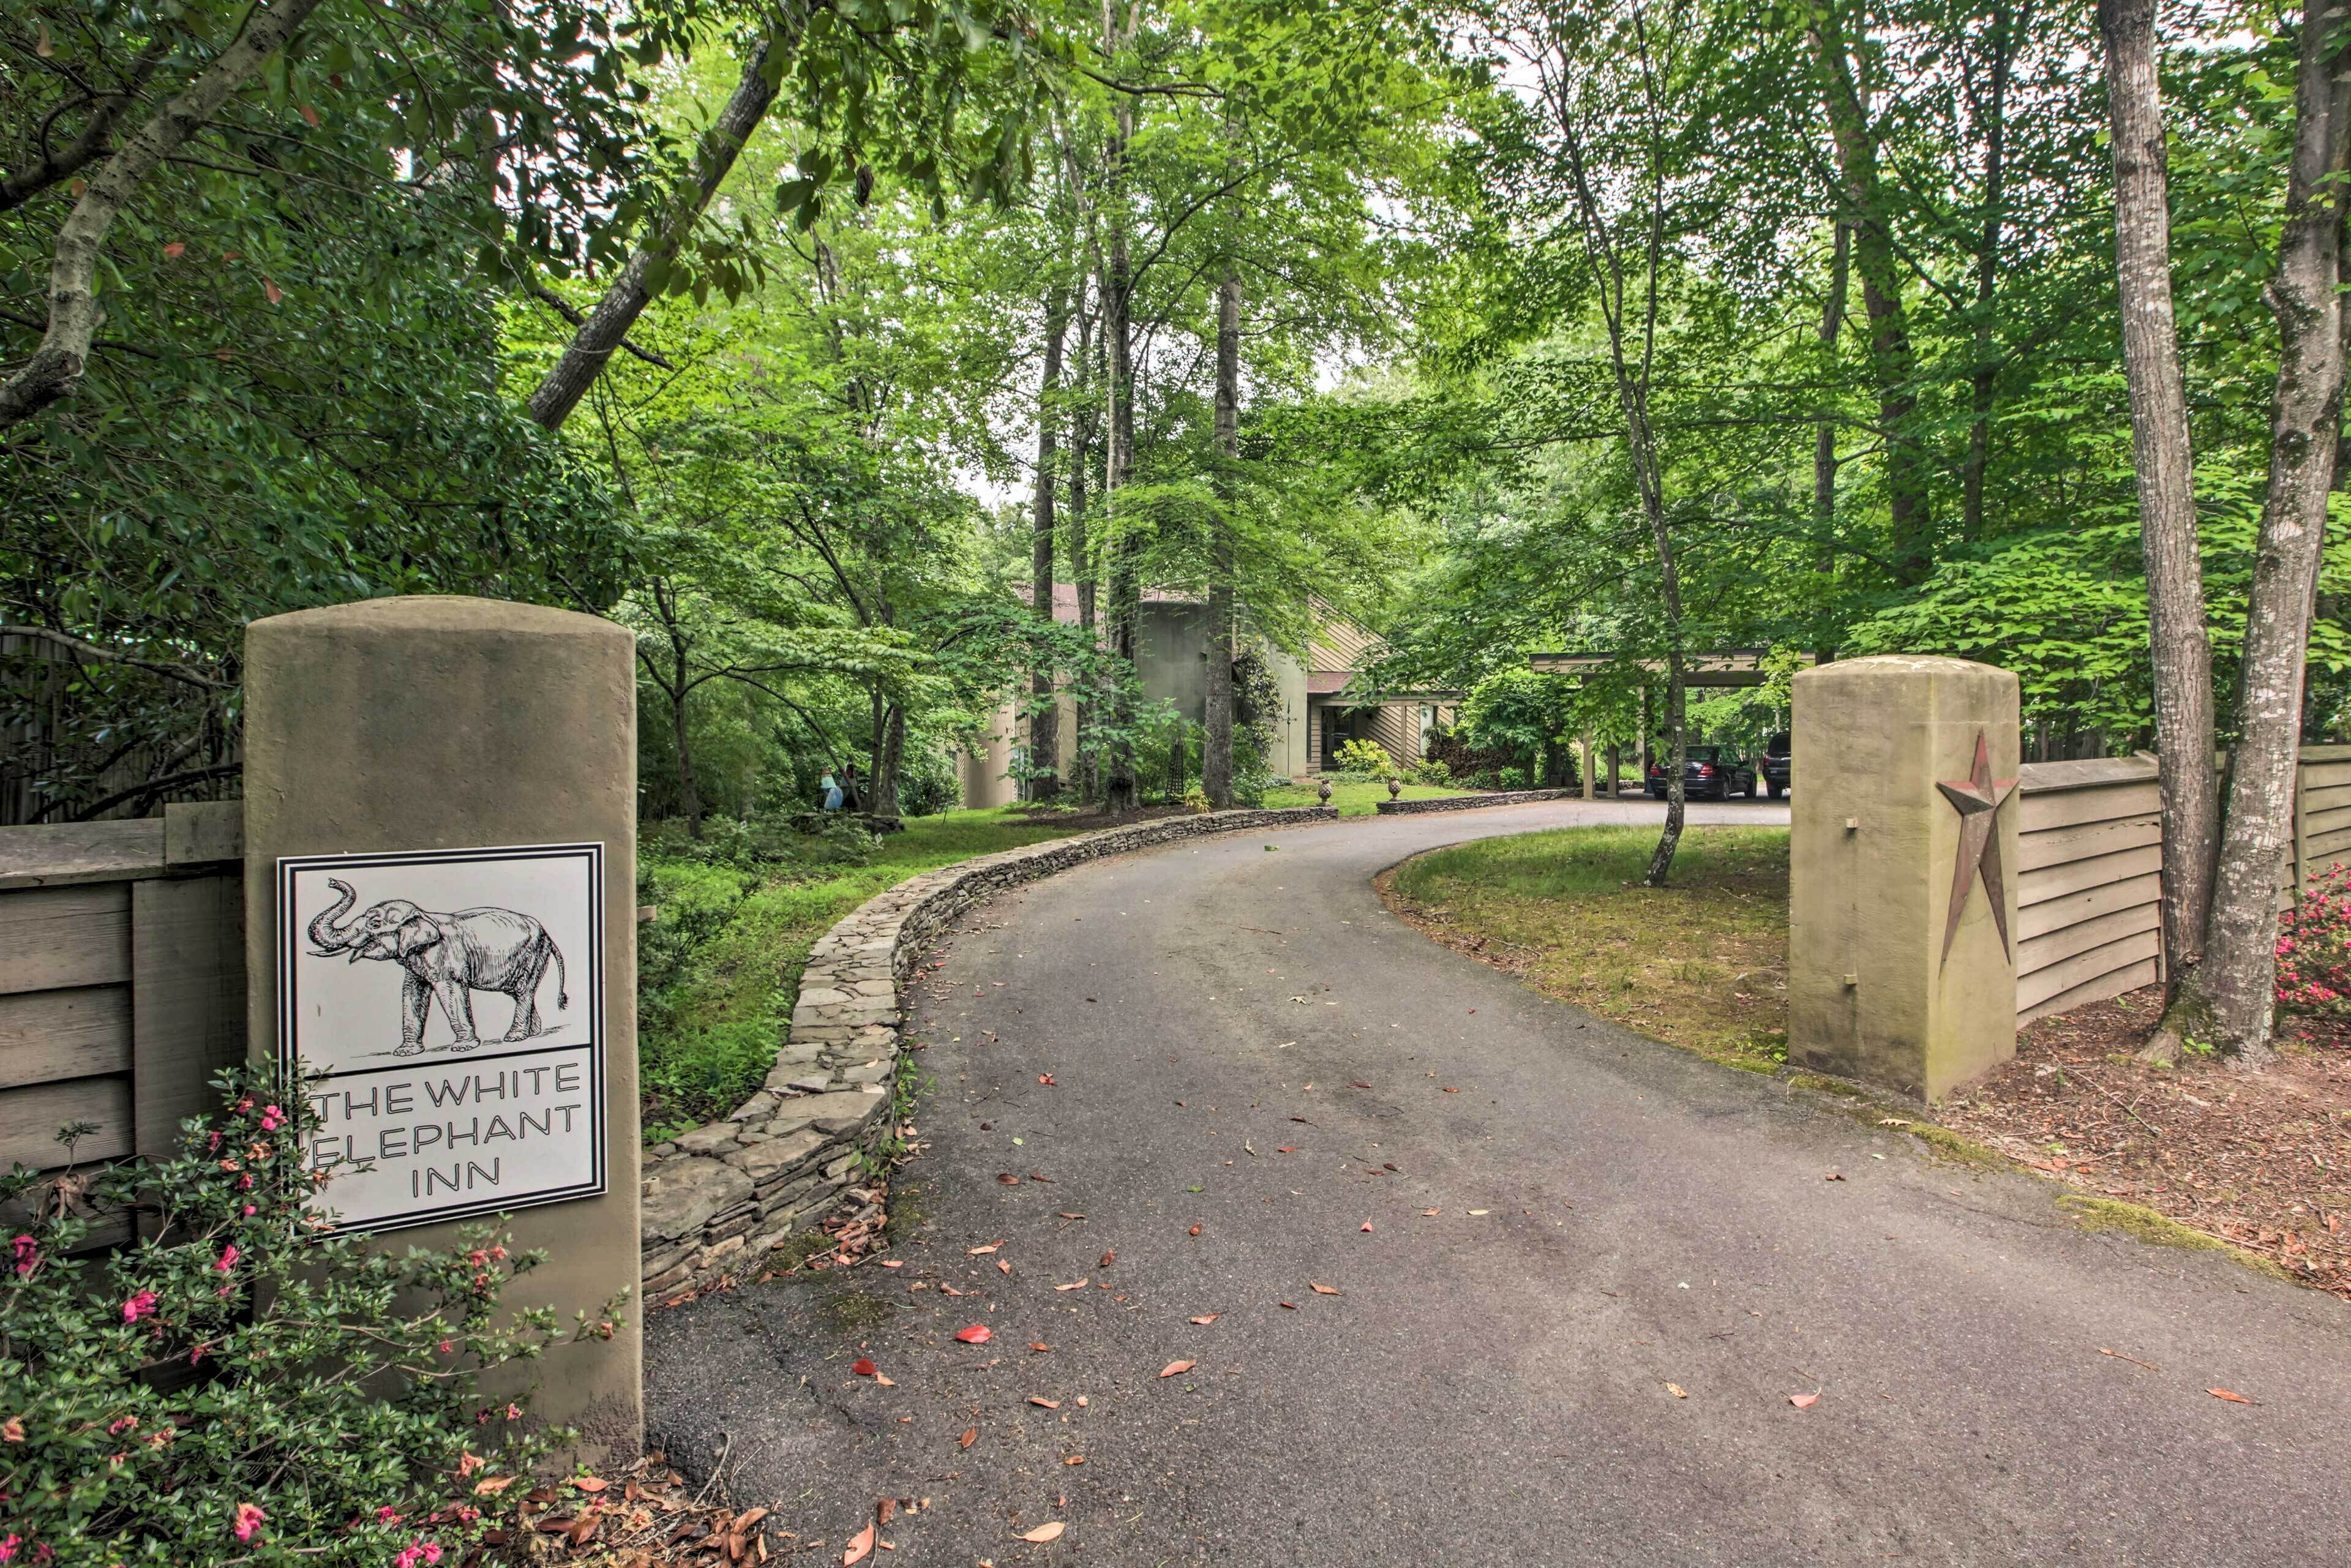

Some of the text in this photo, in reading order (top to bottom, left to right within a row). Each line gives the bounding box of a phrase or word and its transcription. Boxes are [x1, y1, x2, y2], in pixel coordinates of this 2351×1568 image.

[309, 1063, 580, 1122] THE WHITE
[312, 1104, 581, 1168] ELEPHANT
[412, 1157, 500, 1198] INN
